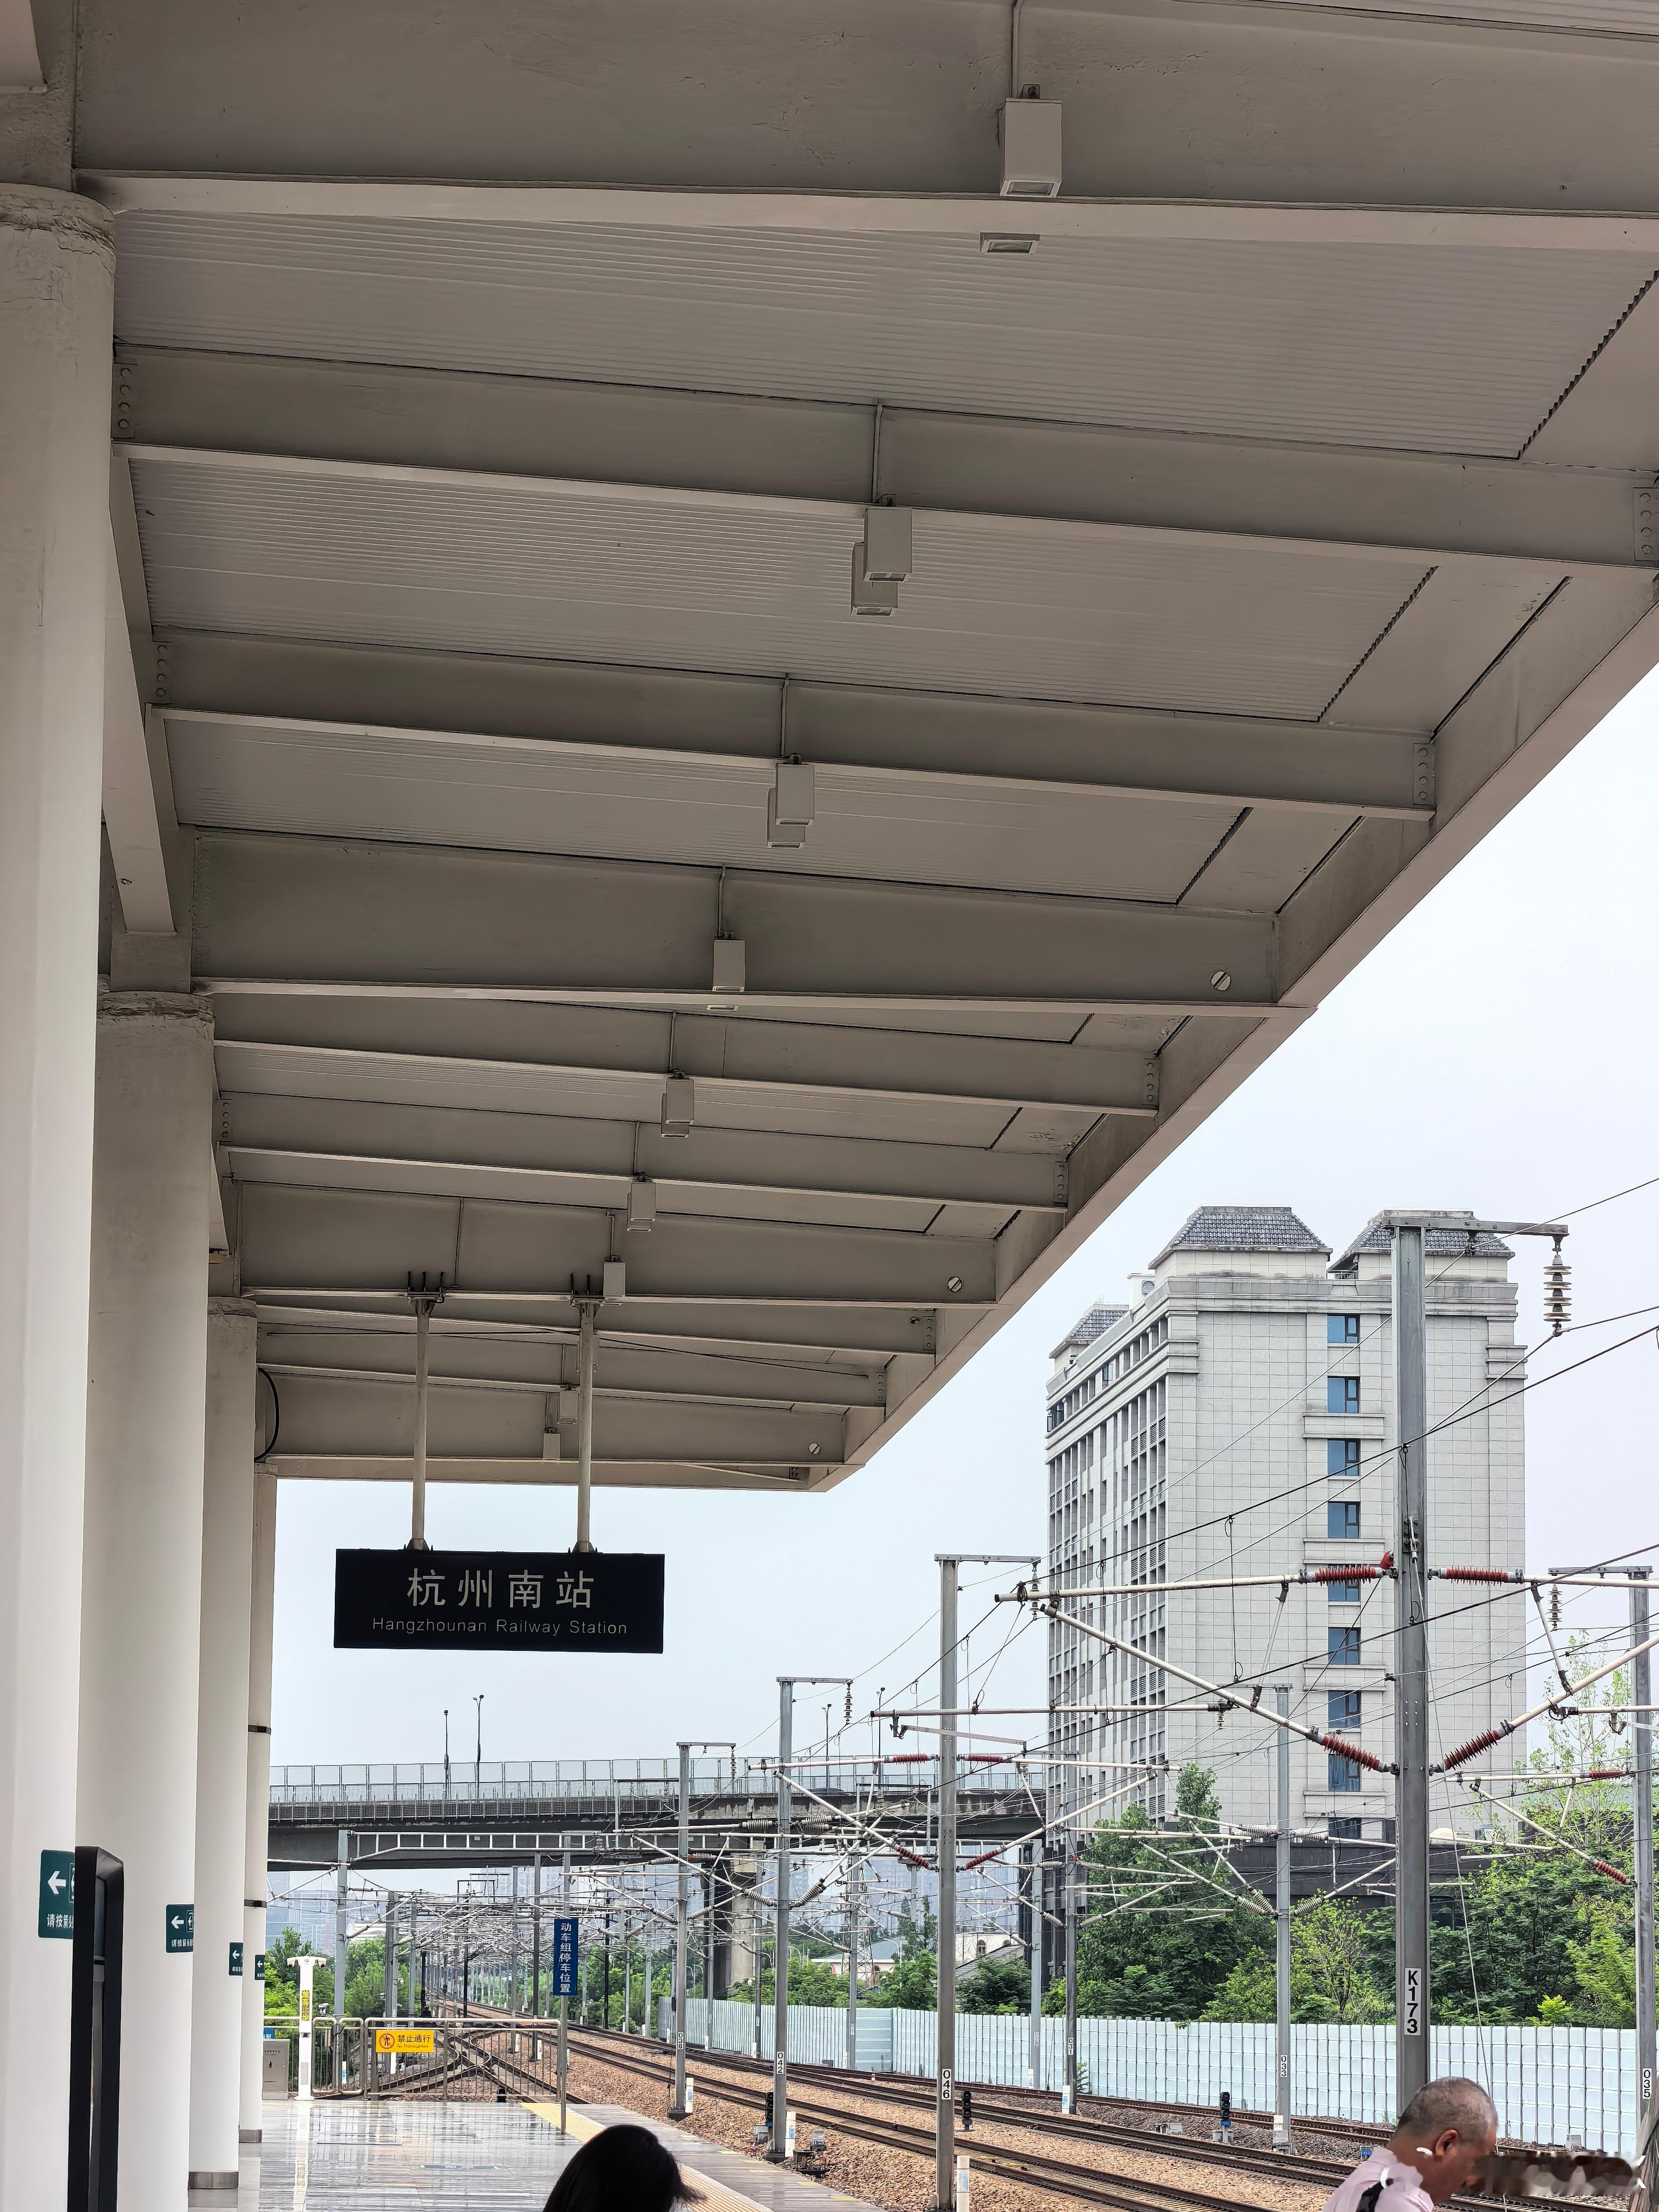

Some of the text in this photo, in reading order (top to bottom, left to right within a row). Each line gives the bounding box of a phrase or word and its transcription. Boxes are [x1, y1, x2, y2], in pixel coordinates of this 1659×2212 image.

[407, 1568, 594, 1608] 杭州南站
[373, 1617, 626, 1636] Hangzhounan Railway Station
[559, 1923, 571, 1993] 动车组停车位置
[1407, 1970, 1418, 2034] K173
[397, 2034, 431, 2043] 禁止通行
[942, 2069, 950, 2099] 046
